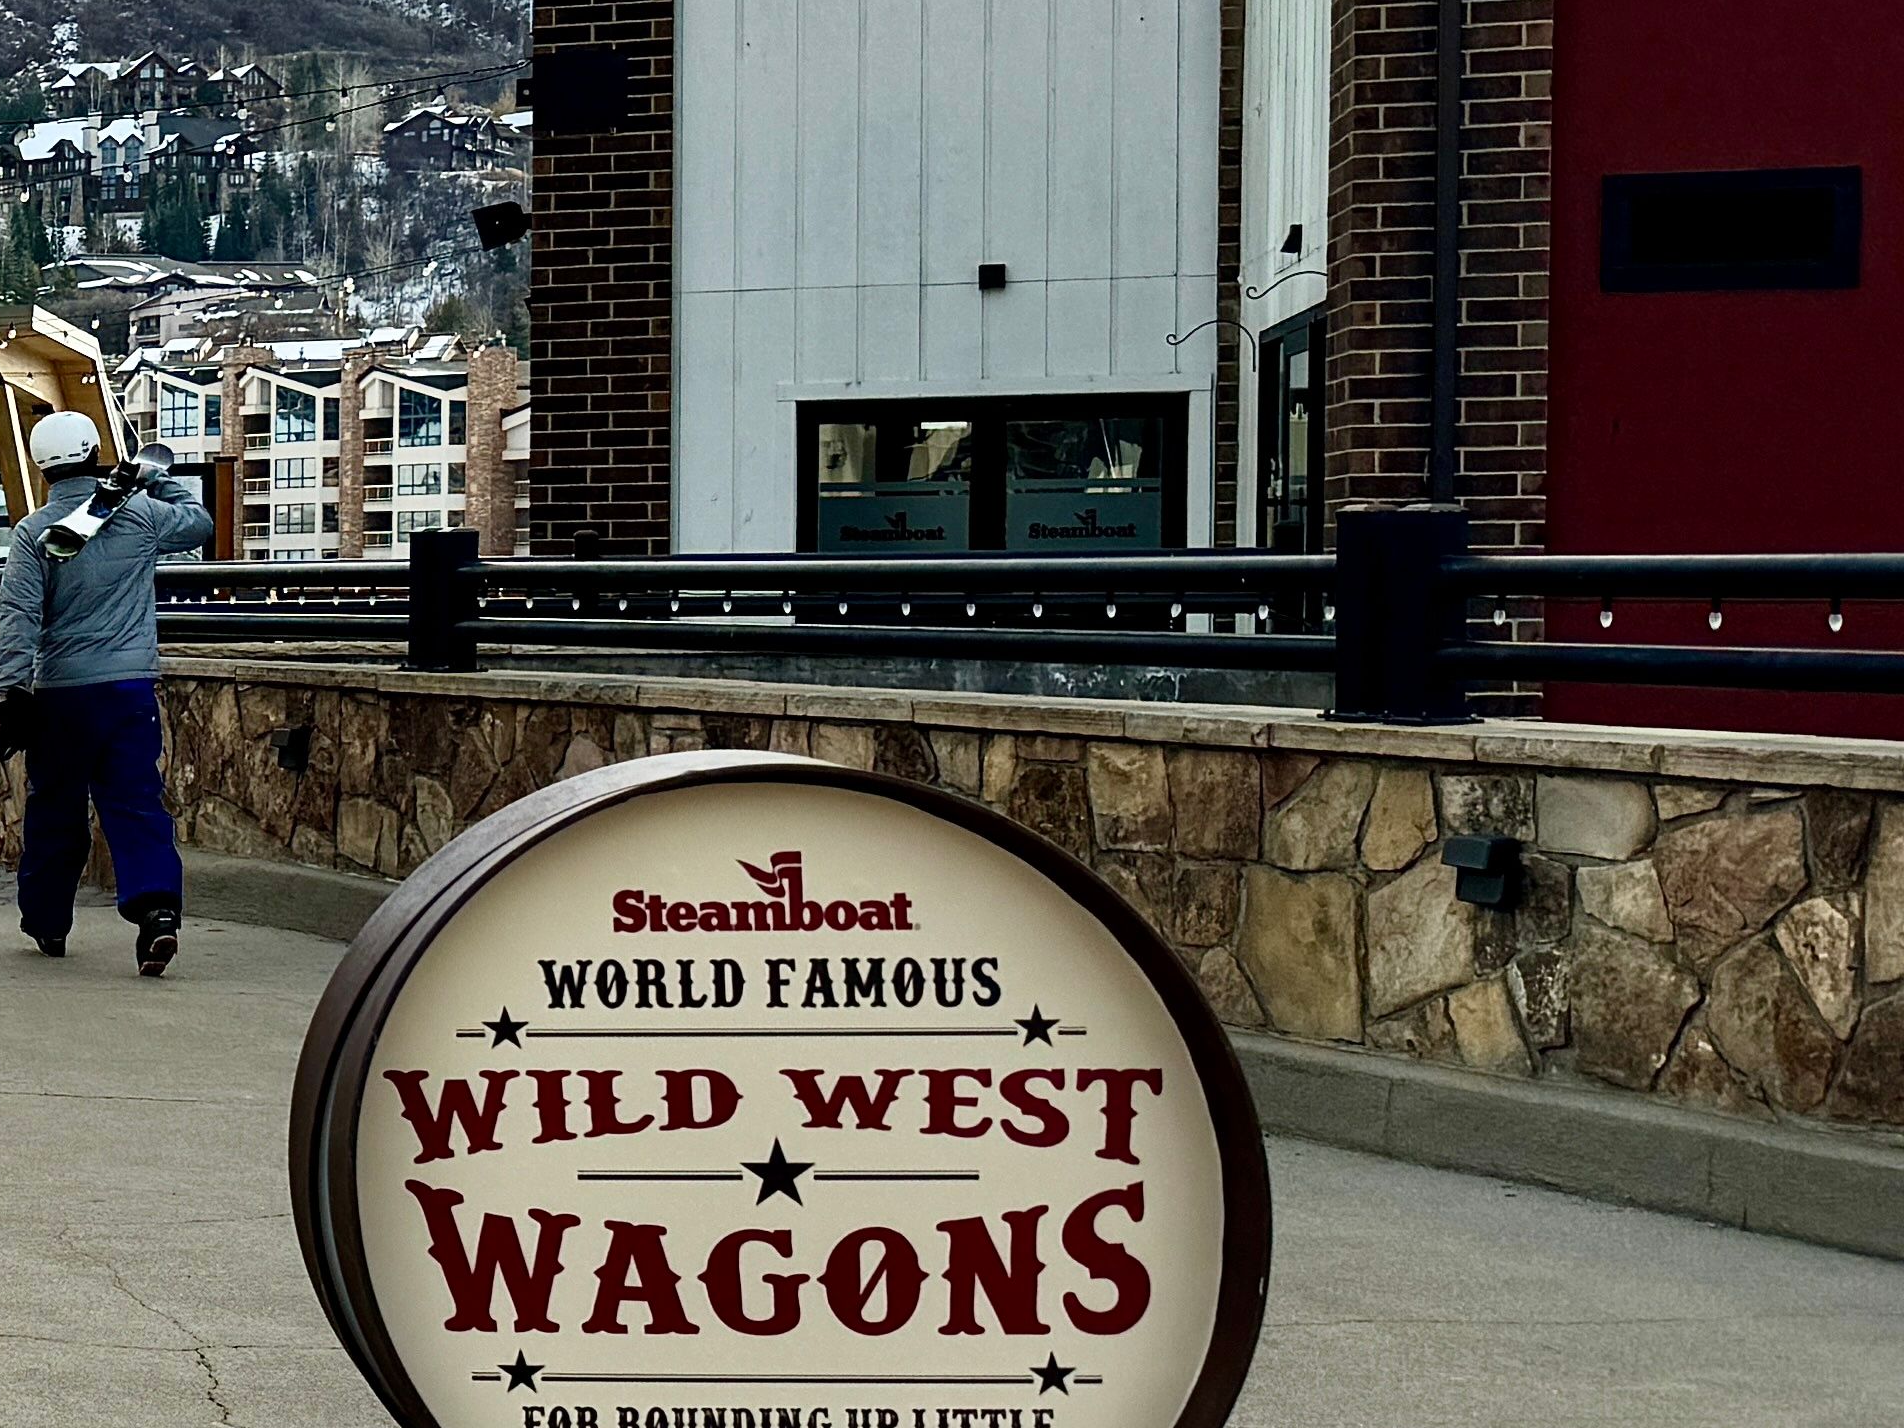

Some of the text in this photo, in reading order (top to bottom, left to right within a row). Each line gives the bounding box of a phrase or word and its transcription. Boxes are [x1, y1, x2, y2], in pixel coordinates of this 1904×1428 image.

[840, 511, 946, 541] Steamboat
[1027, 509, 1137, 539] Steamboat
[612, 851, 913, 933] Steamboat
[538, 956, 1002, 1010] WORLD FAMOUS
[382, 1068, 1164, 1166] WILD WEST
[405, 1178, 1152, 1337] WAGONS
